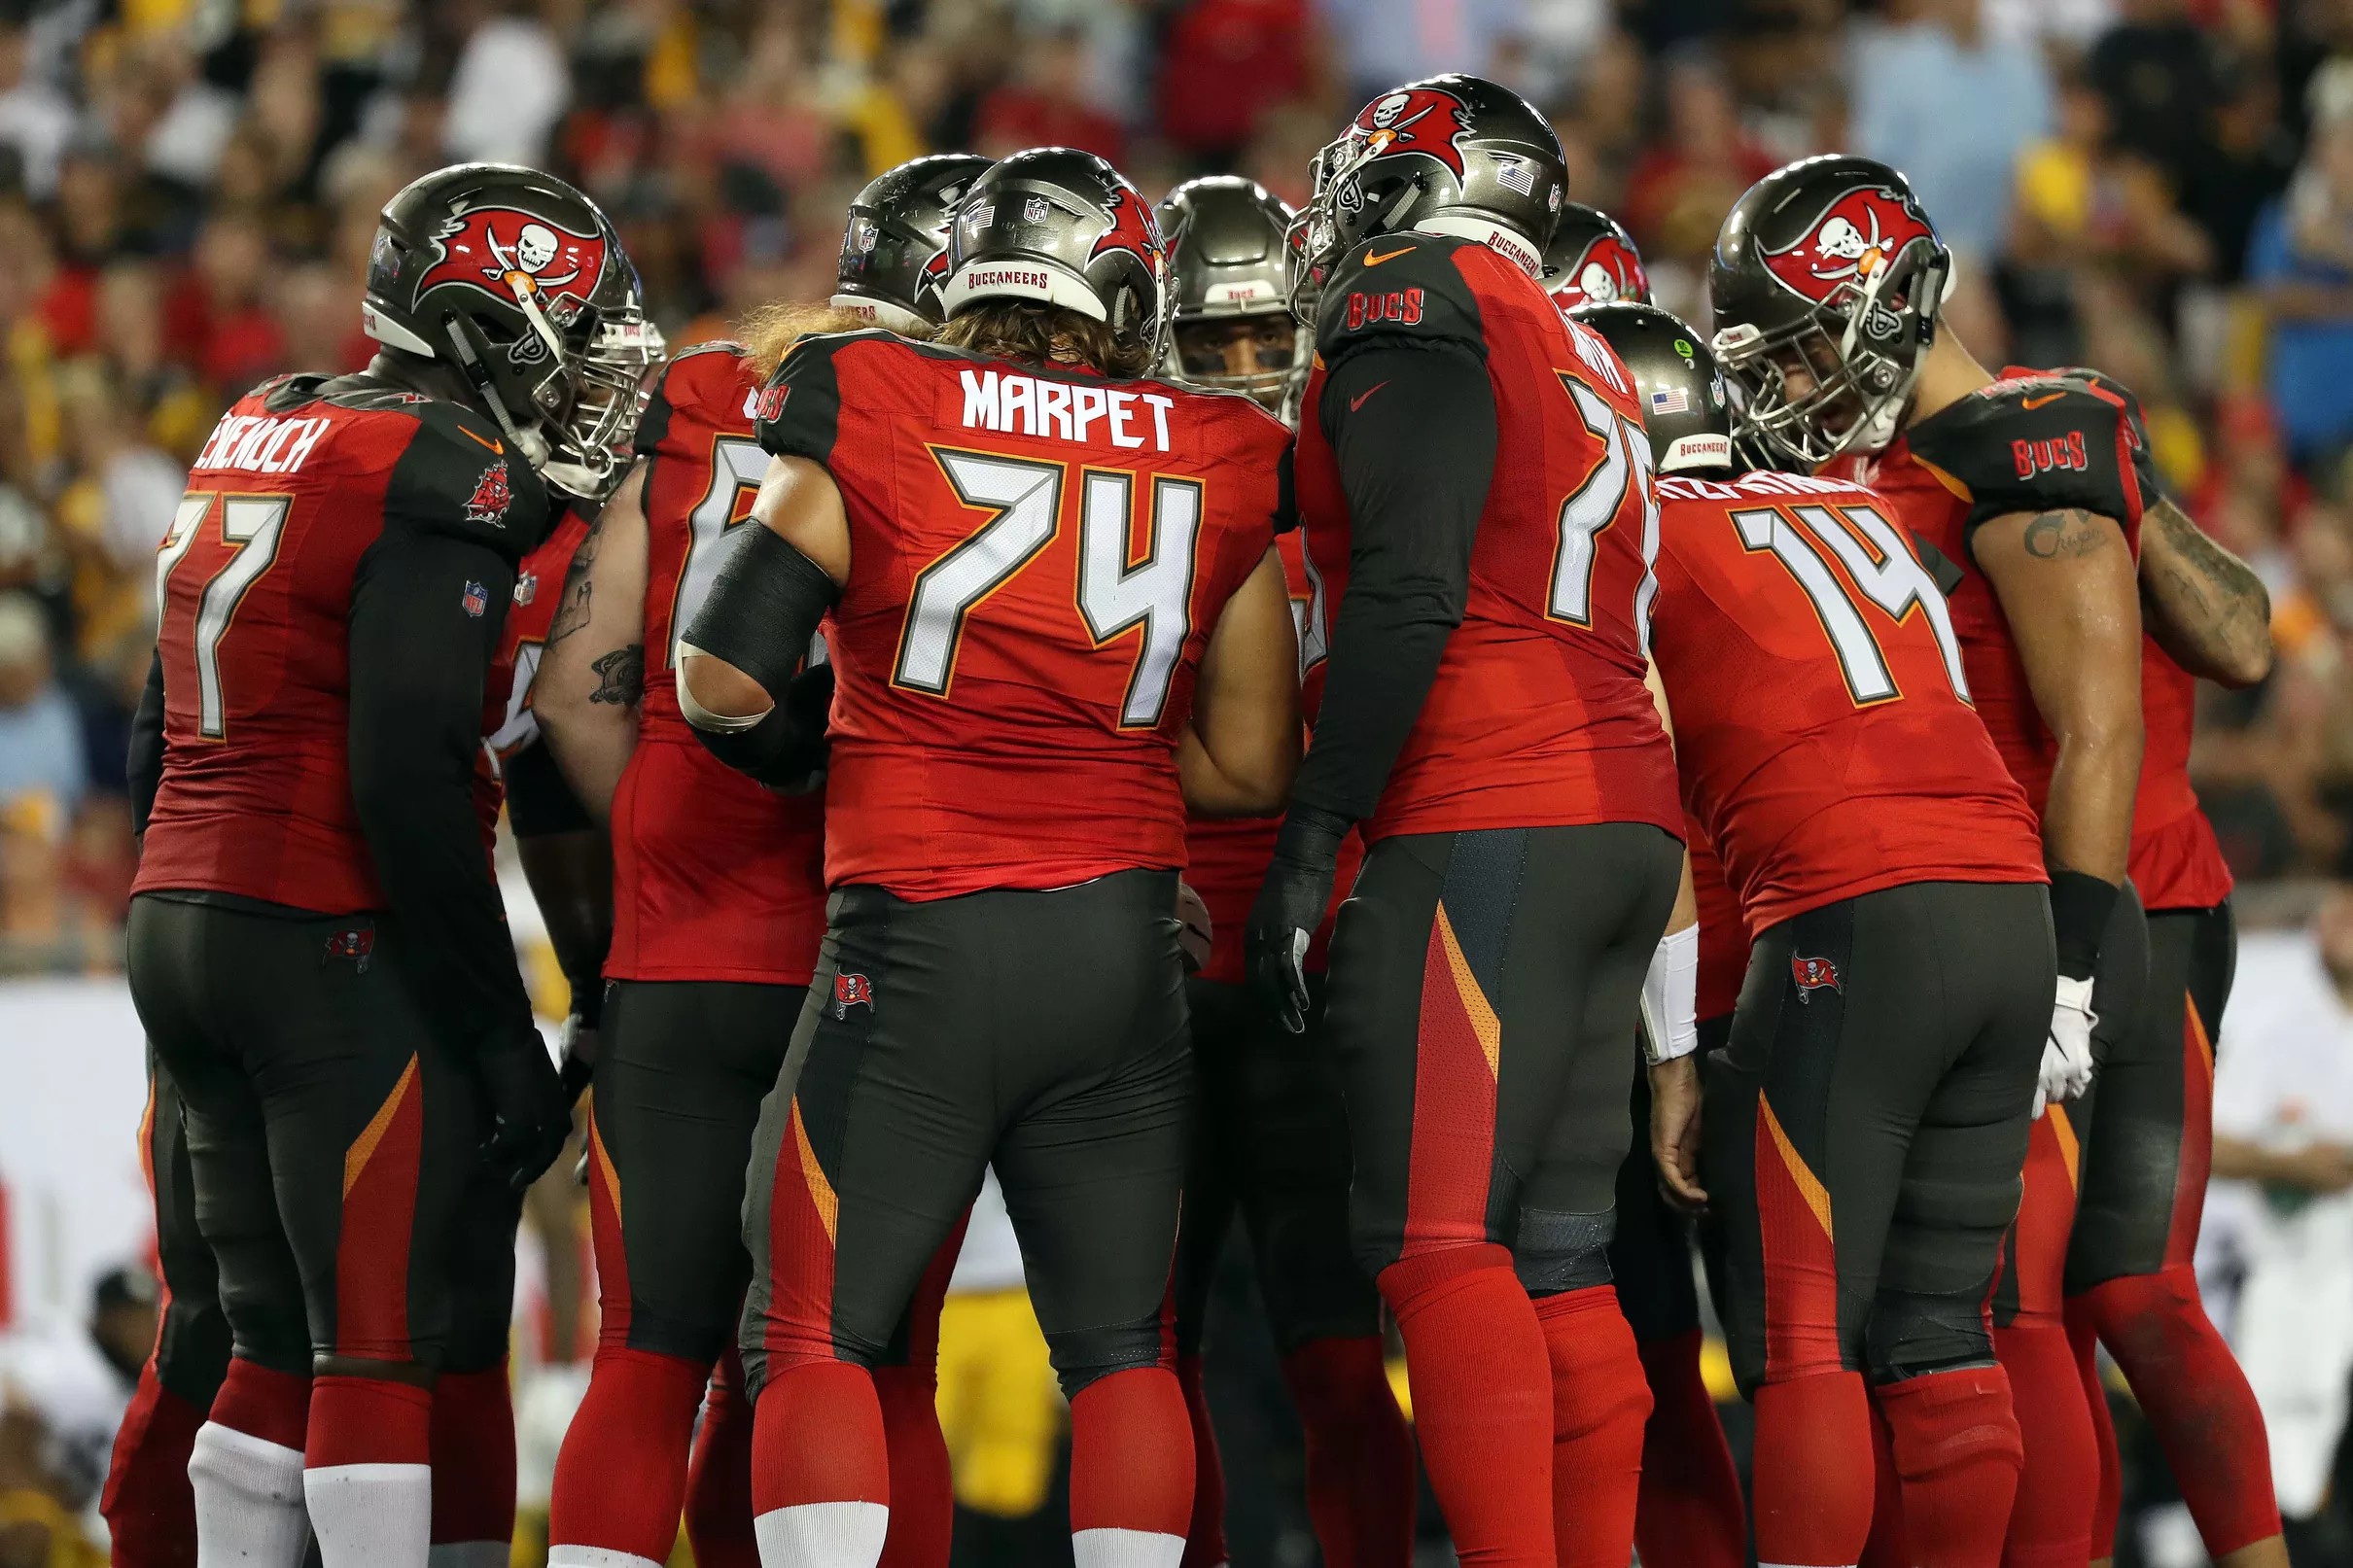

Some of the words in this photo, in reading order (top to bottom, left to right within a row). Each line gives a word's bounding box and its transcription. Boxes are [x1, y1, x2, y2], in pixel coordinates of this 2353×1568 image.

[1027, 208, 1044, 220] NFL
[968, 271, 1048, 290] BUCCANEERS
[1348, 288, 1423, 331] BUCS
[960, 369, 1175, 452] MARPET
[1680, 441, 1727, 457] BUCCANEERS
[2010, 431, 2089, 481] BUCS
[889, 442, 1206, 731] 74
[1725, 503, 1976, 712] 14
[157, 490, 296, 744] 77
